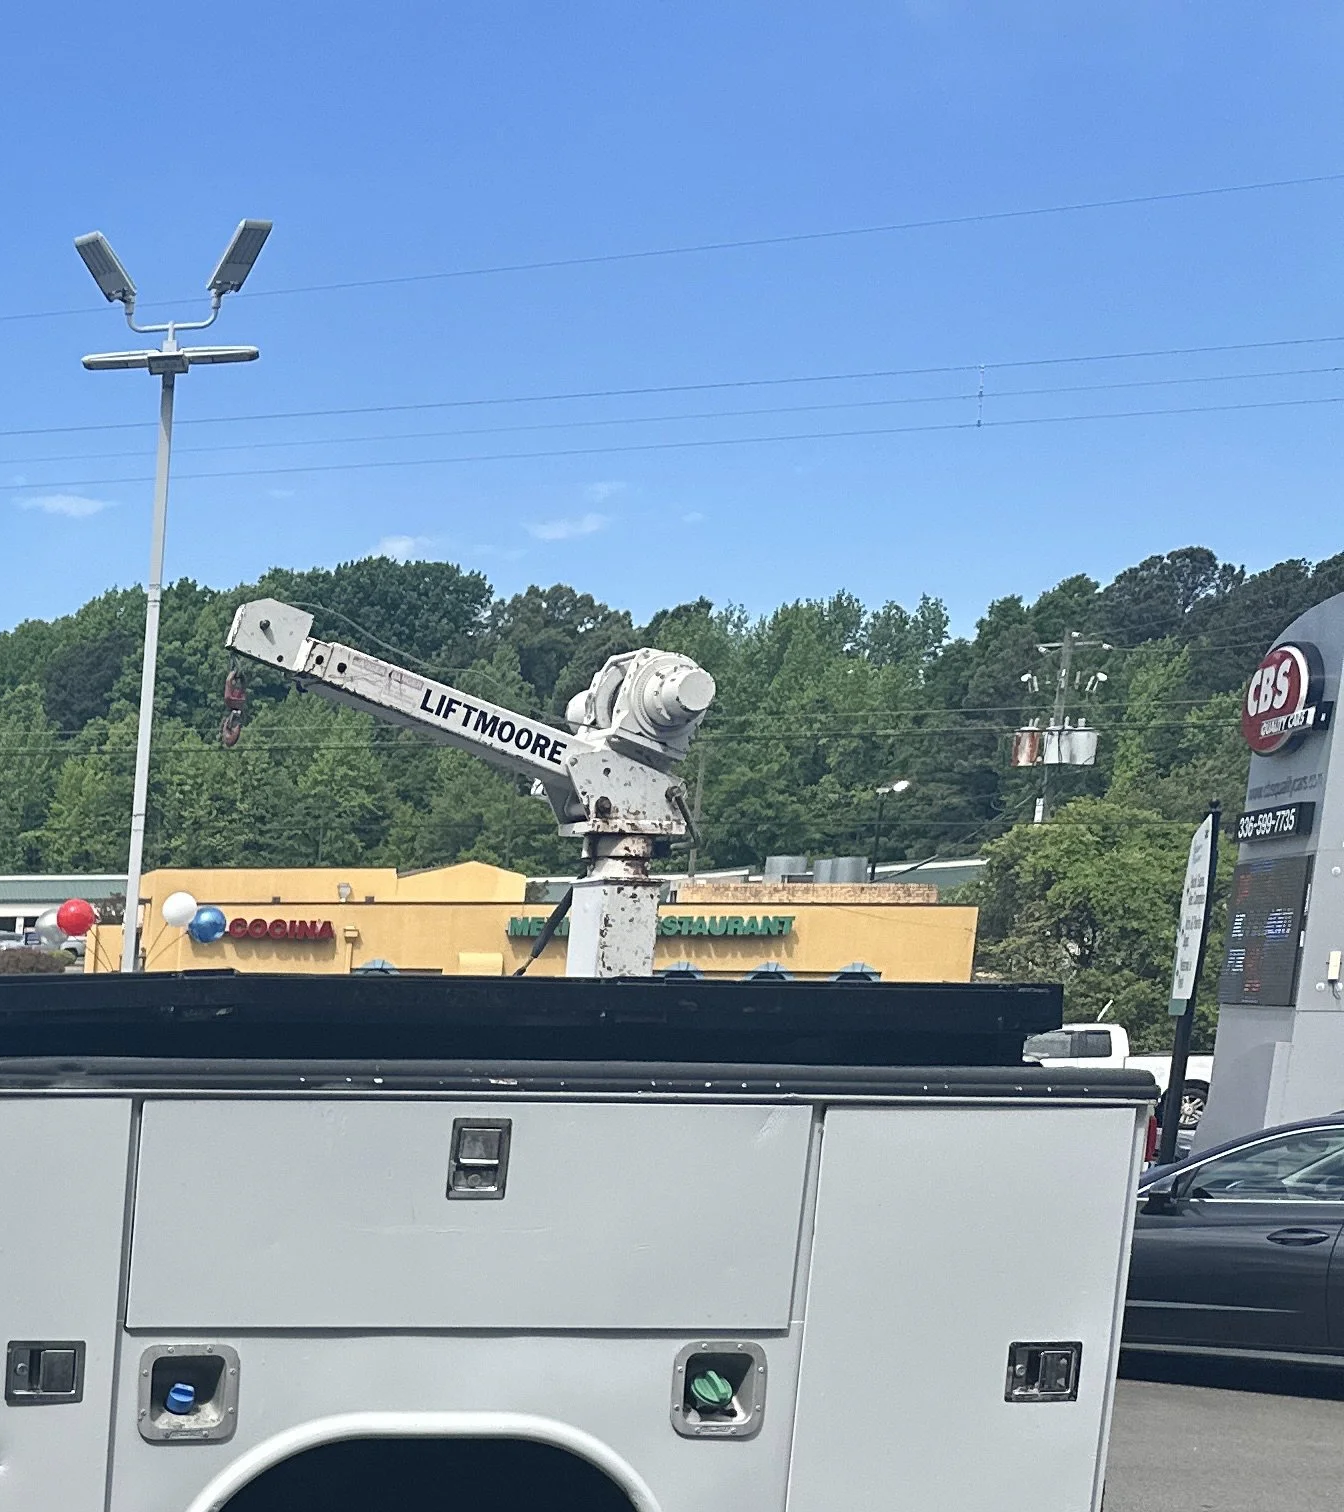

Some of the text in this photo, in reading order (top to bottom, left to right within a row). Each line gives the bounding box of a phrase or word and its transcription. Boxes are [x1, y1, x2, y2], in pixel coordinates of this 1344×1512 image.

[1247, 657, 1293, 718] CBS
[419, 688, 568, 766] LIFTMOORE
[1237, 808, 1296, 839] 336-599-7735
[656, 915, 796, 937] STAURANT
